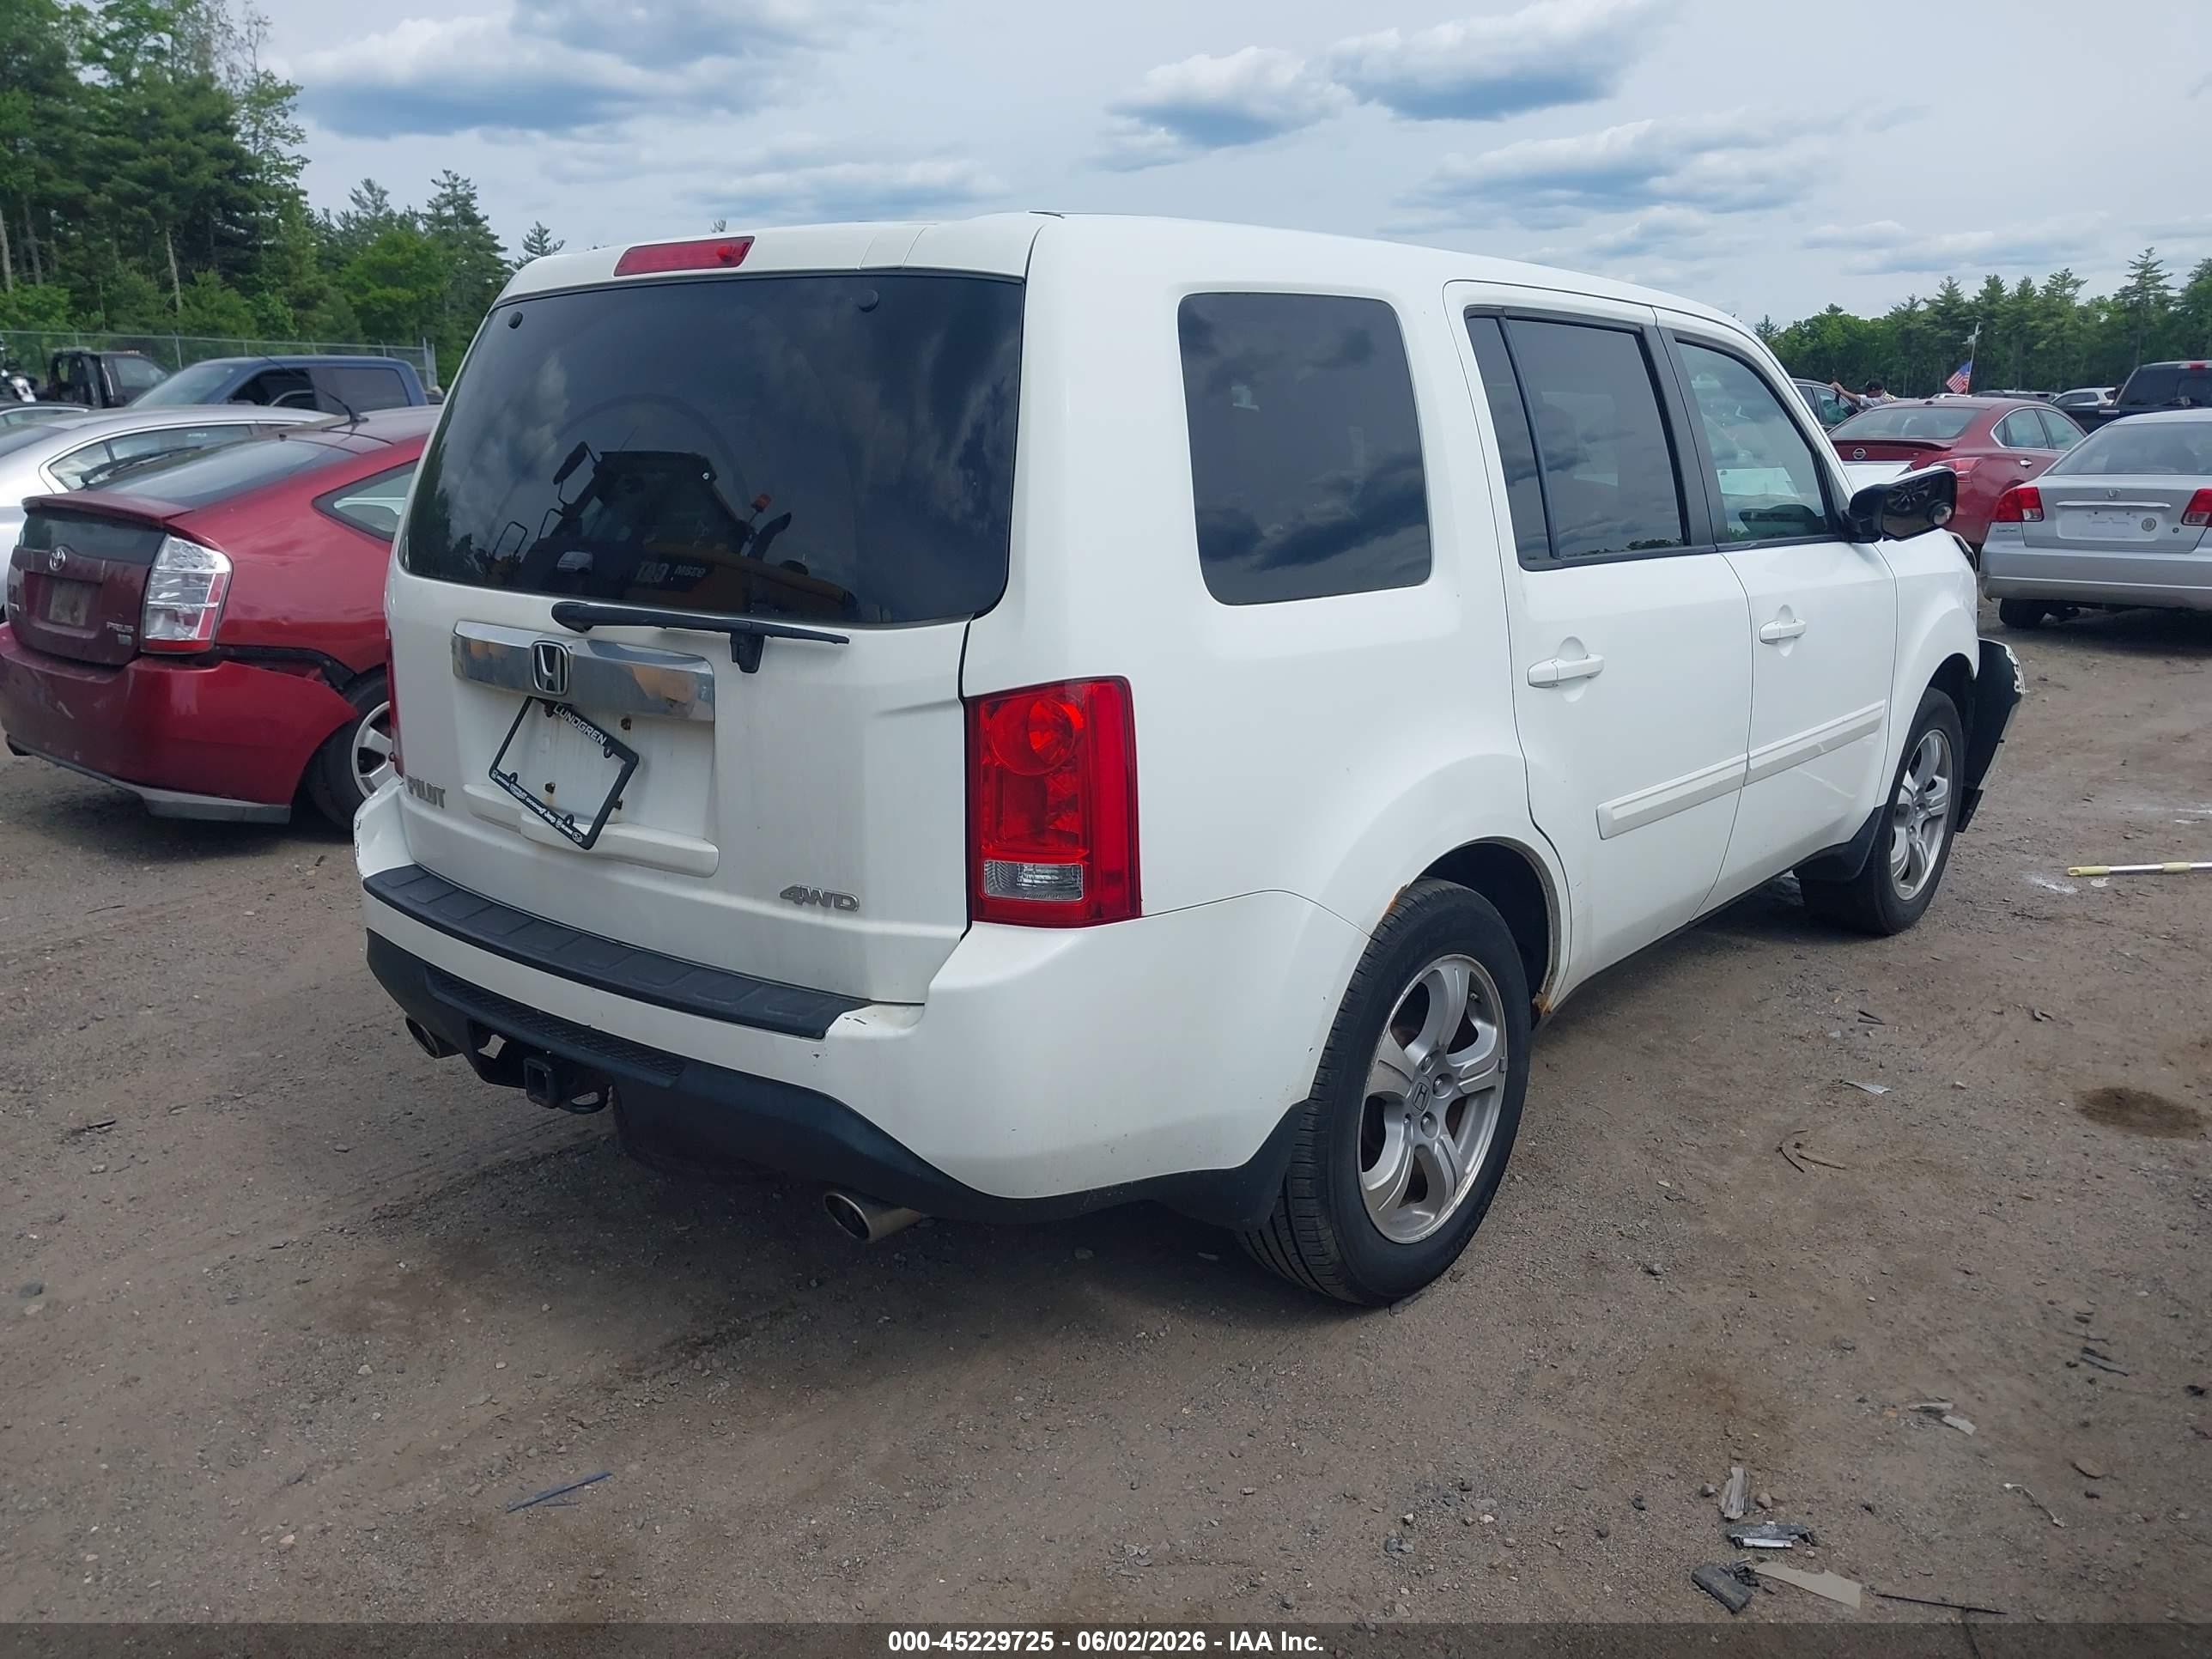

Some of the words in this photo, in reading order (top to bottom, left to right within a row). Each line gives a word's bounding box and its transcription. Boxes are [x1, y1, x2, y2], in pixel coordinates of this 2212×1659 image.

[552, 702, 607, 745] LUNDGREN
[406, 775, 446, 809] PILOT
[780, 884, 860, 912] 4WD
